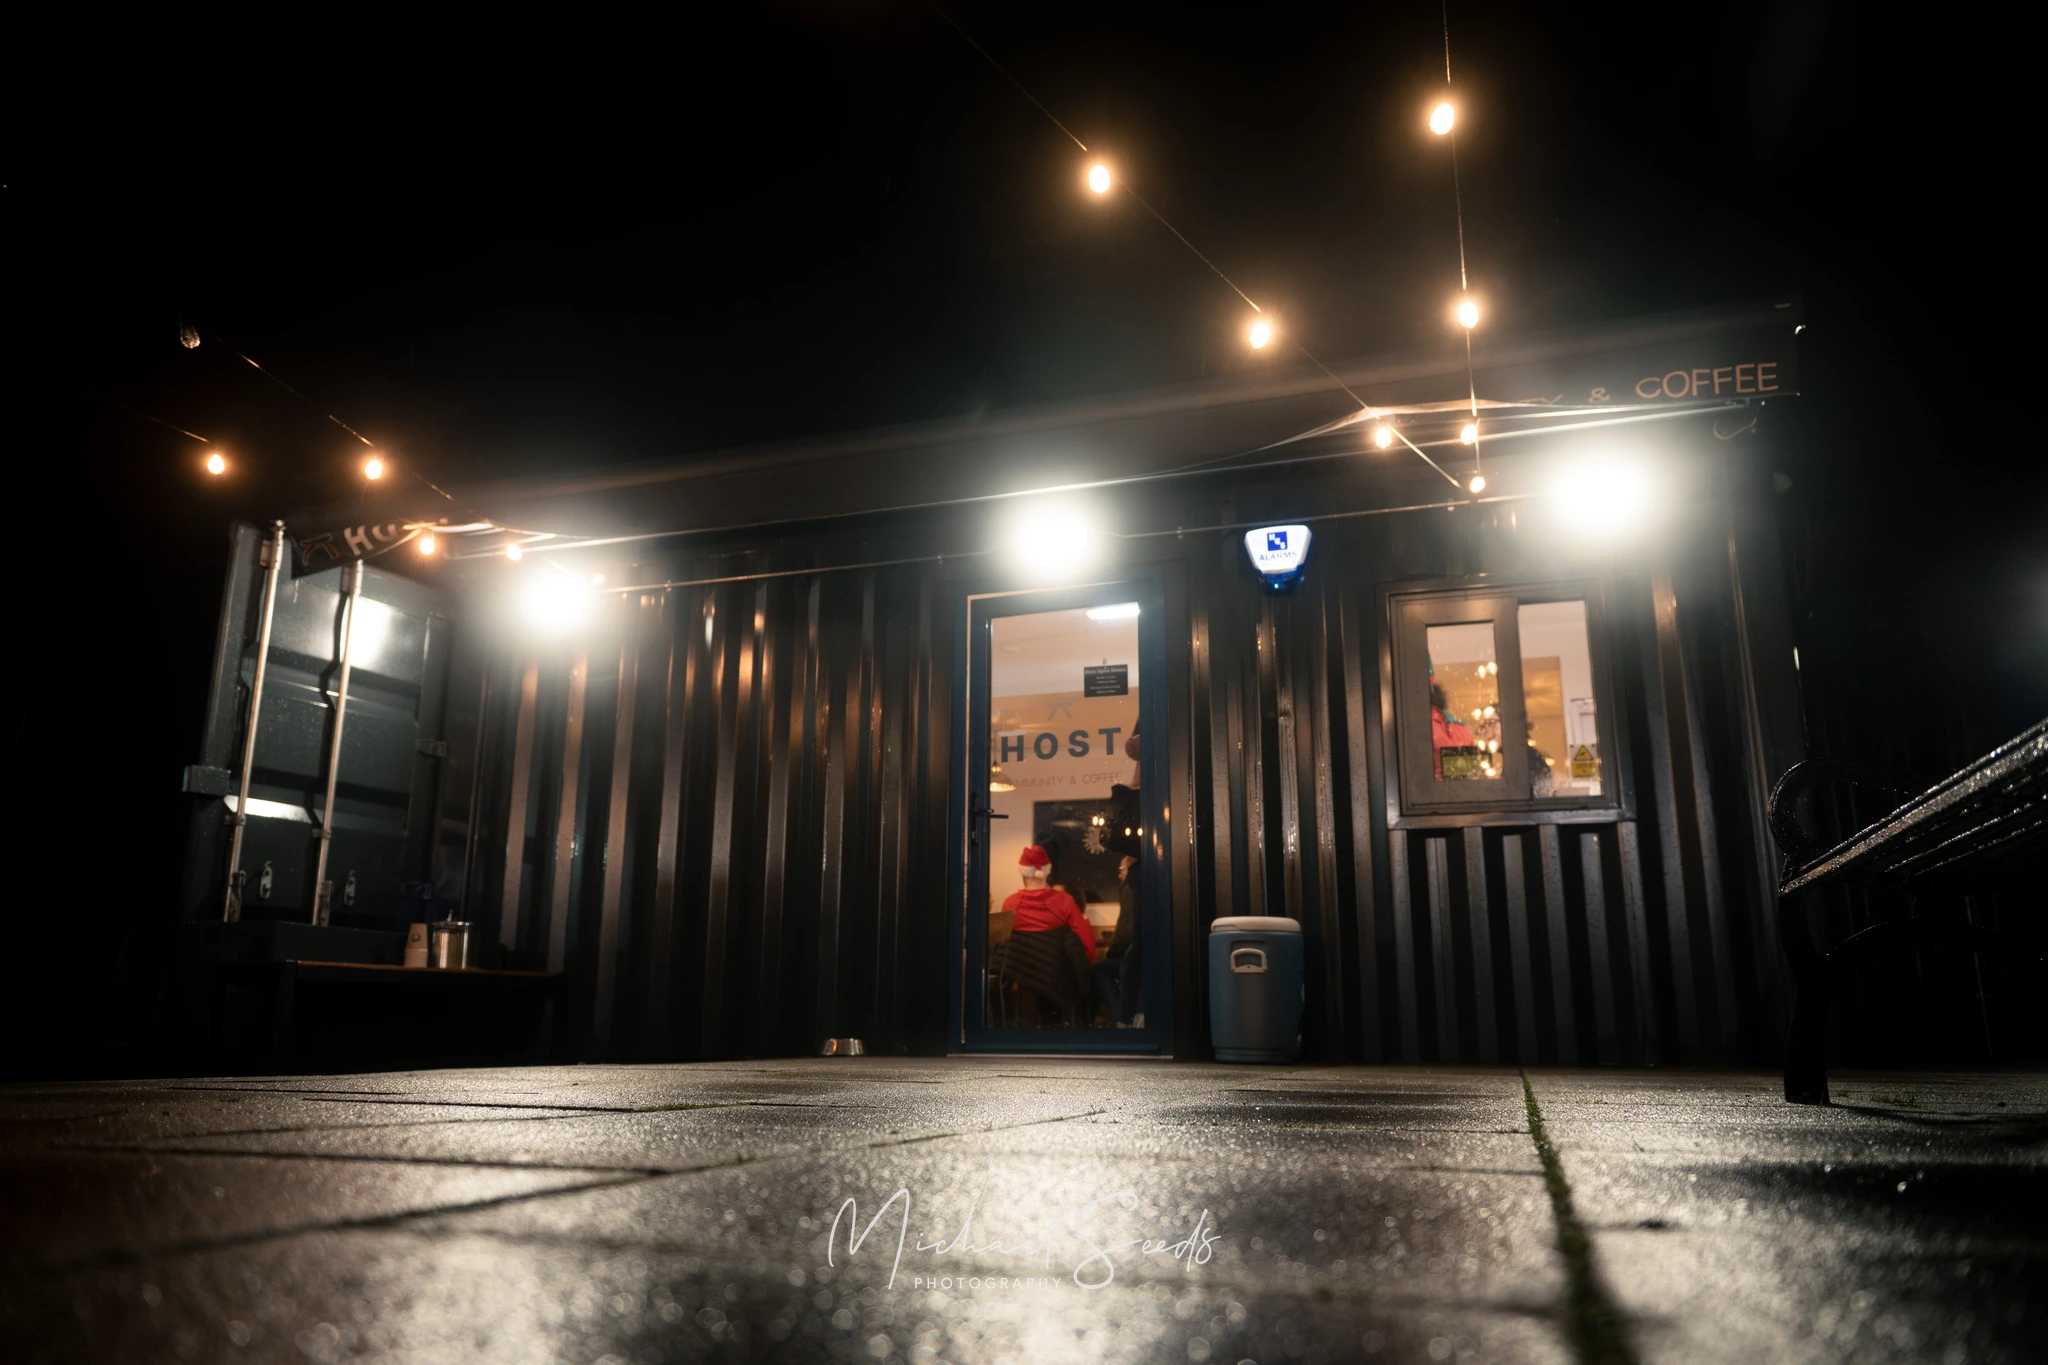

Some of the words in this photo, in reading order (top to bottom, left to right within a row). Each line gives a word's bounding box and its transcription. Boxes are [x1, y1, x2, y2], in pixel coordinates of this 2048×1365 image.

[1635, 363, 1779, 399] COFFEE
[1259, 551, 1298, 561] ALARMS
[1001, 727, 1122, 763] HOST
[1082, 772, 1122, 784] COFFEE
